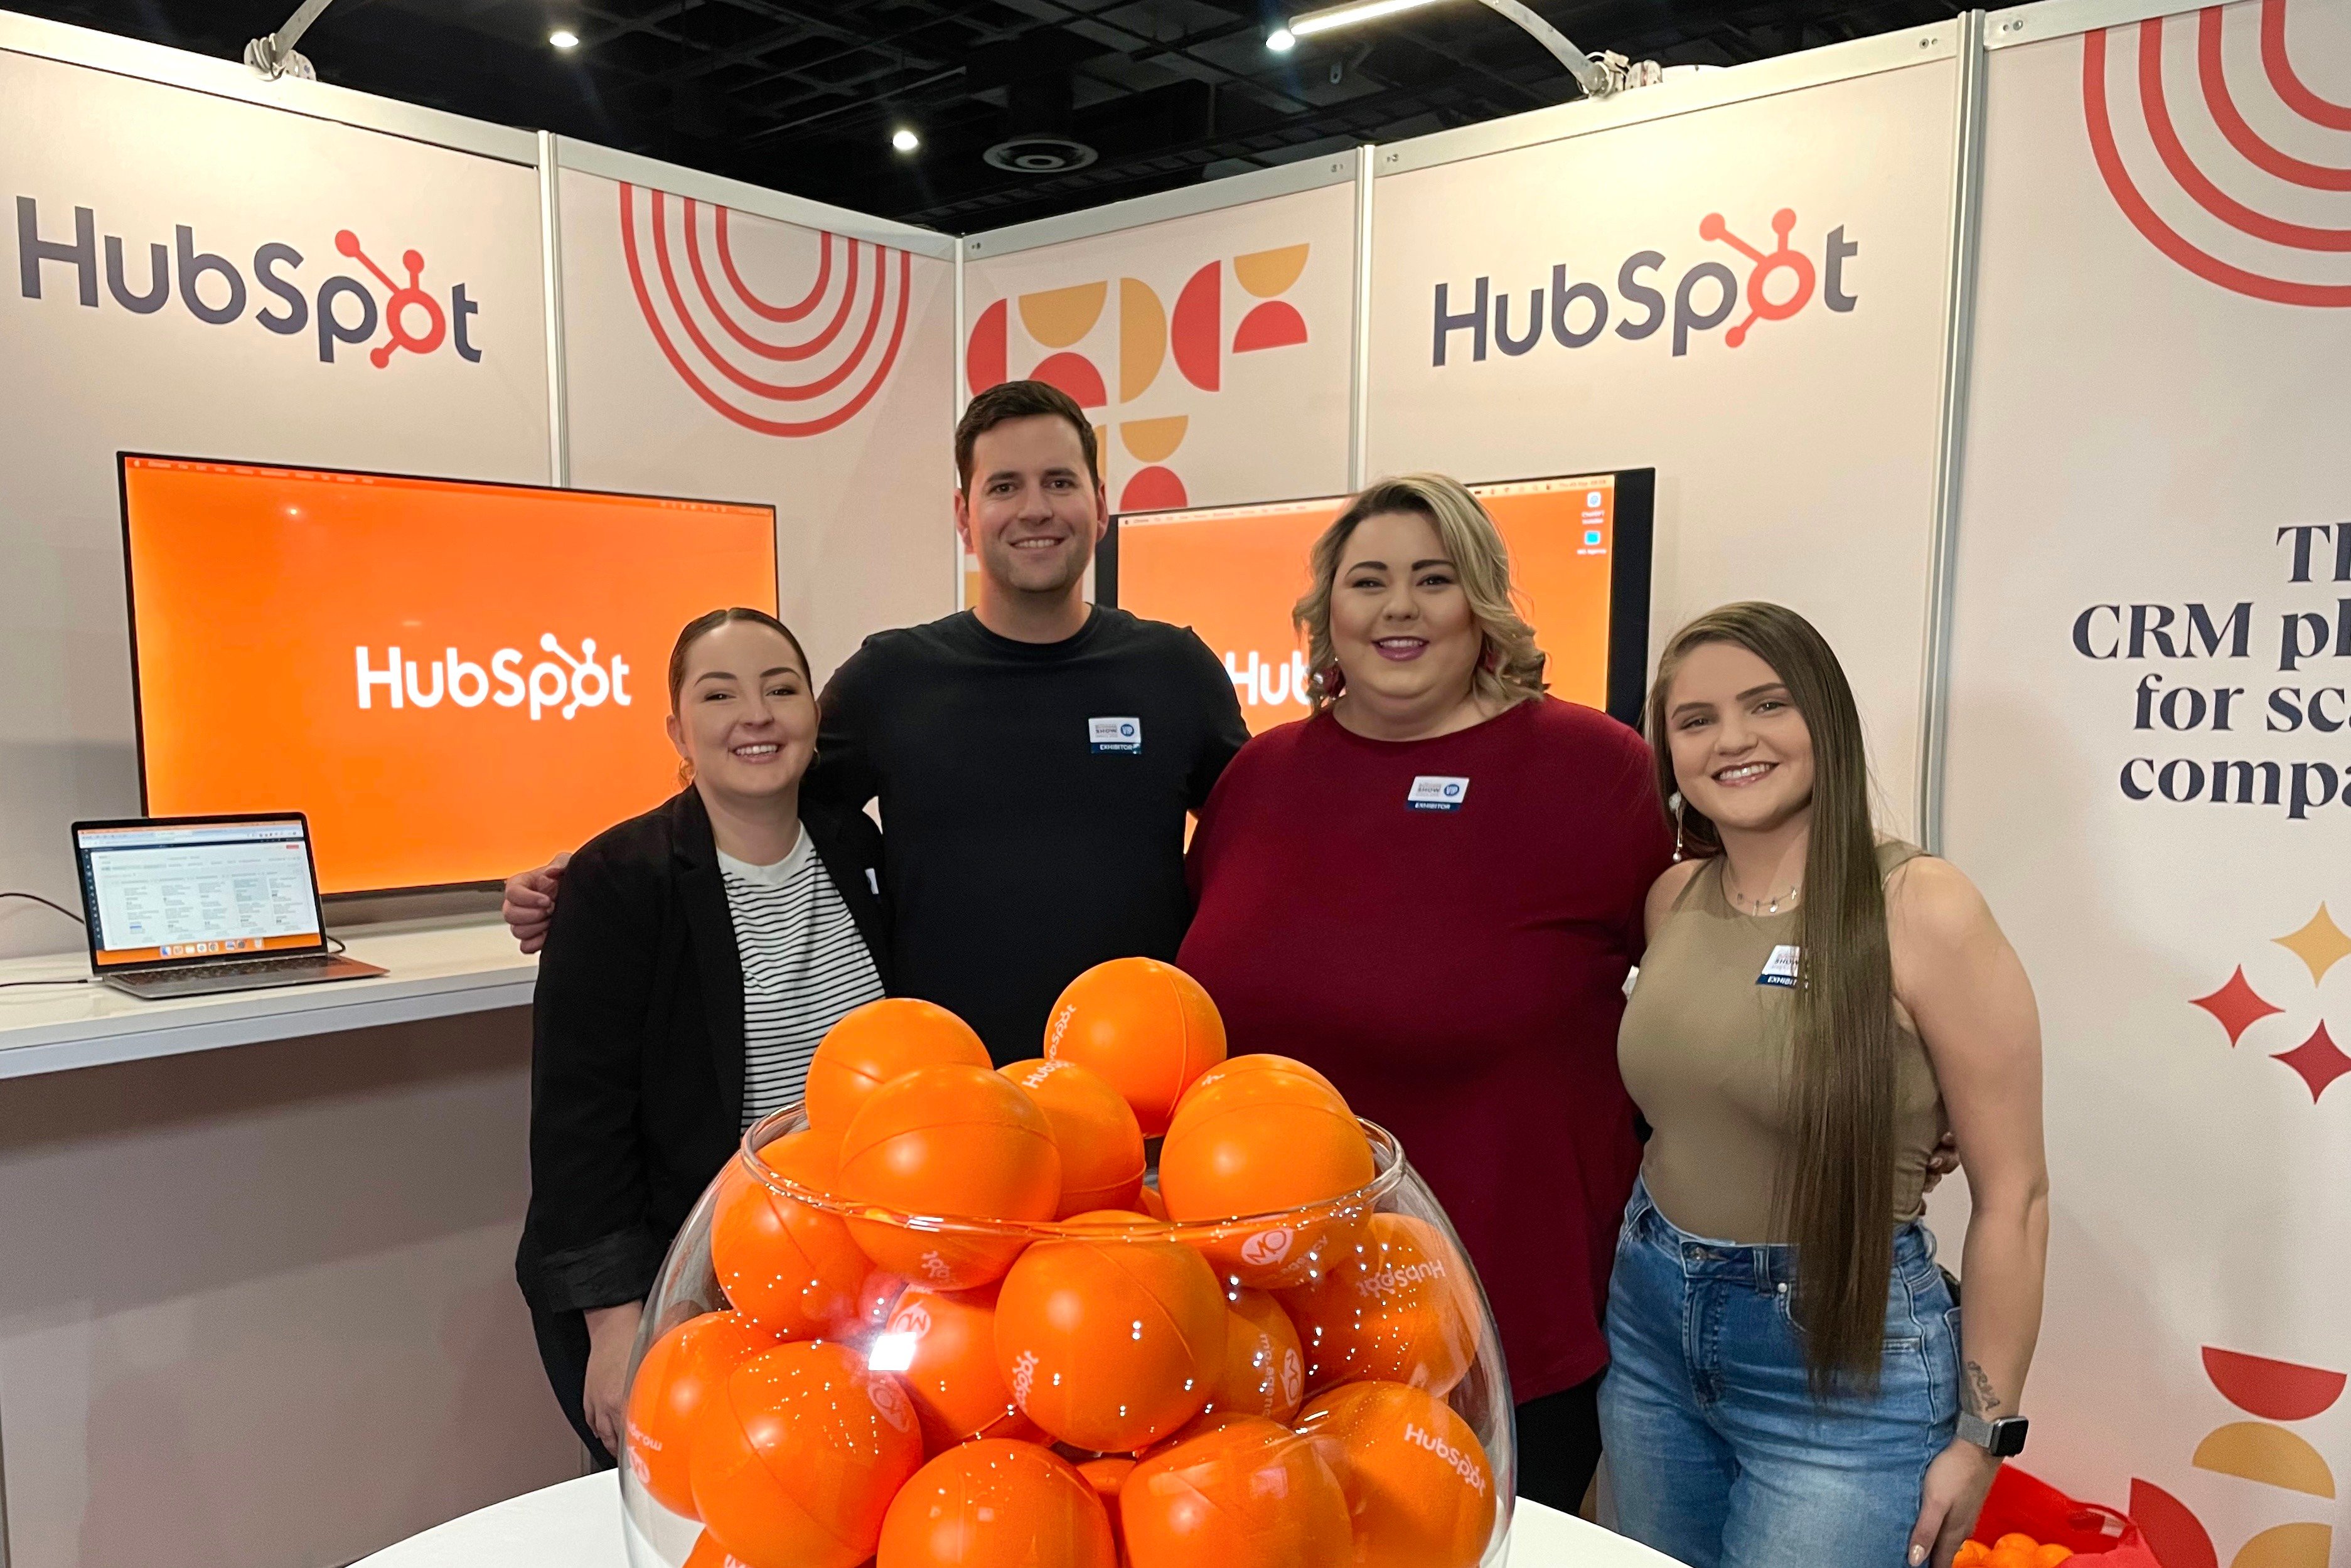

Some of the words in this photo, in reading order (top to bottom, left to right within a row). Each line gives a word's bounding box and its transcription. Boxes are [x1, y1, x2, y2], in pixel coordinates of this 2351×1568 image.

[16, 195, 482, 369] HubSpot
[1432, 208, 1858, 367] HubSpot
[2072, 602, 2254, 659] CRM
[356, 632, 632, 720] HubSpot
[2134, 673, 2244, 730] for
[2266, 687, 2351, 732] sc
[2120, 757, 2351, 819] comp
[1356, 1259, 1446, 1298] HubSpot
[1404, 1423, 1486, 1498] HubSpot
